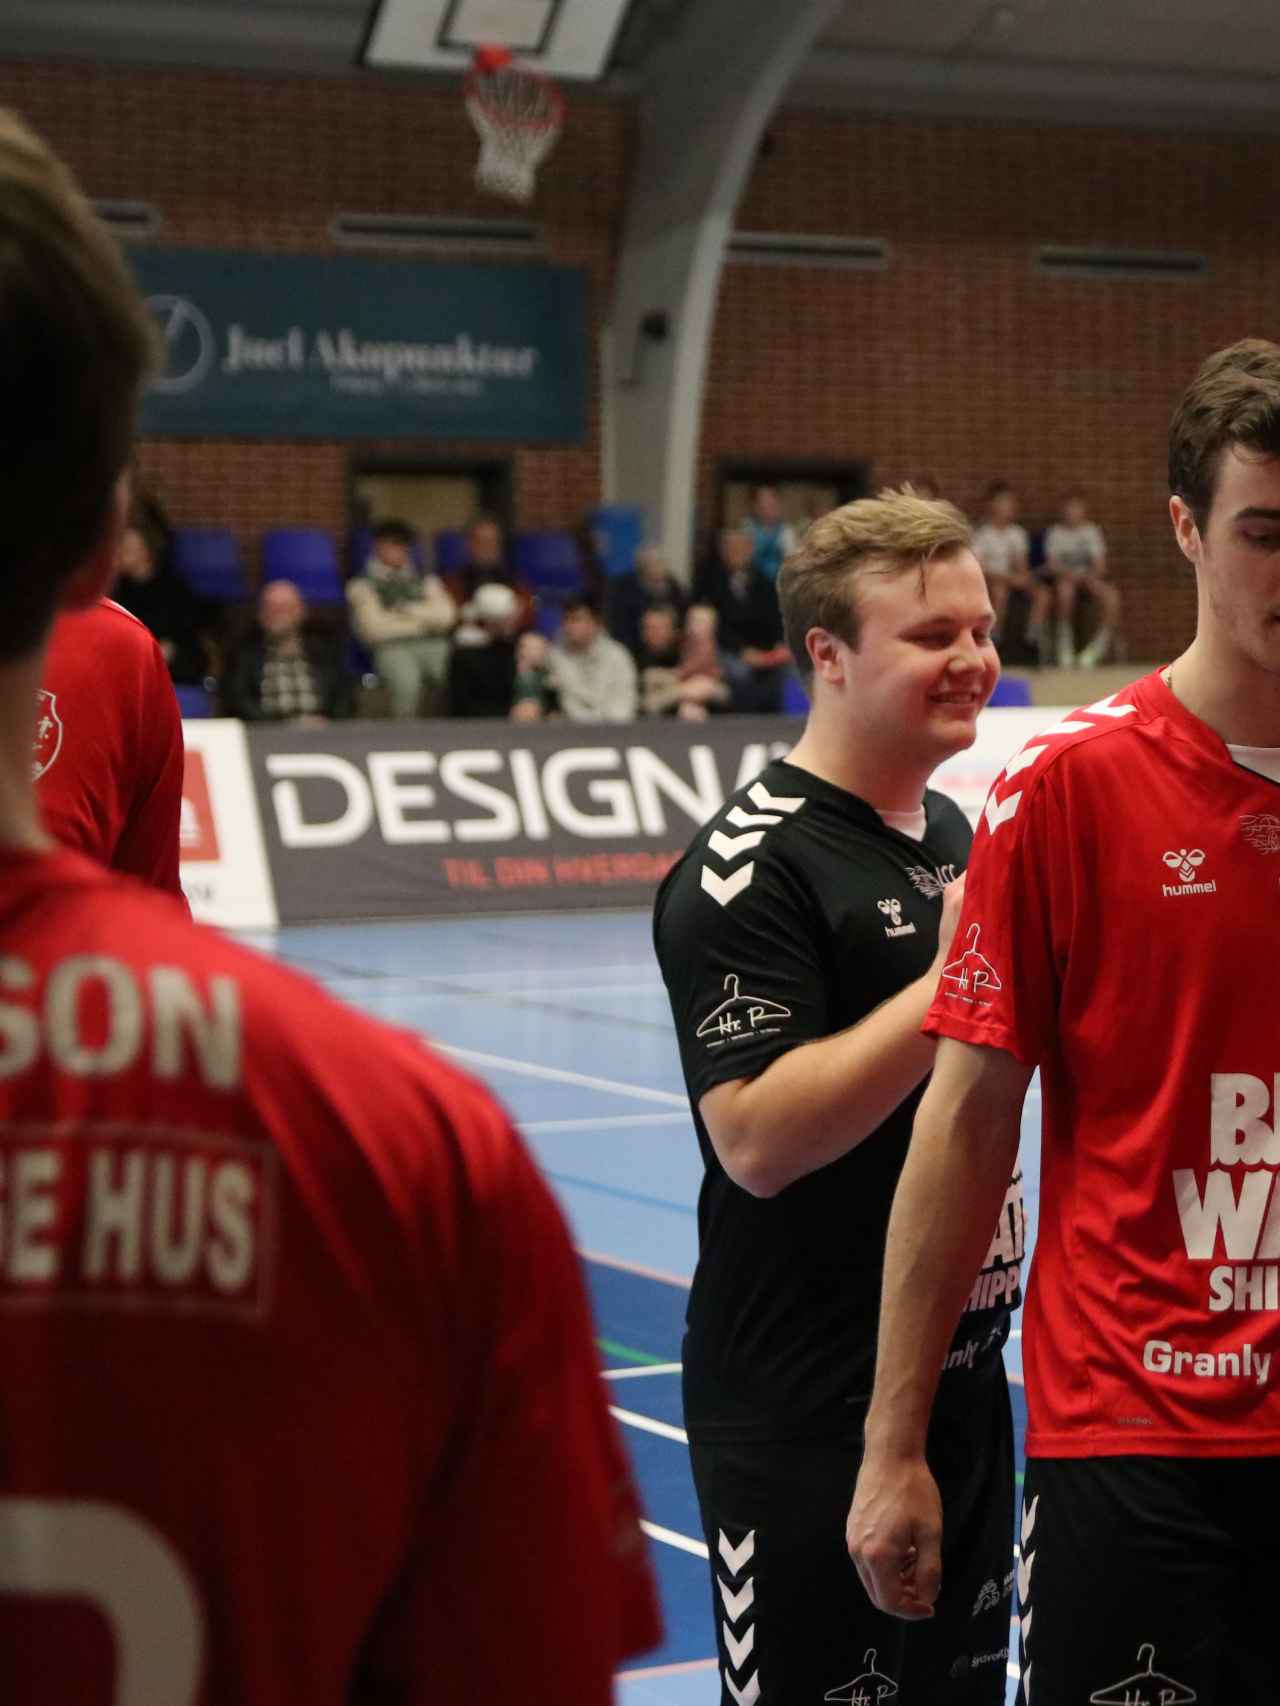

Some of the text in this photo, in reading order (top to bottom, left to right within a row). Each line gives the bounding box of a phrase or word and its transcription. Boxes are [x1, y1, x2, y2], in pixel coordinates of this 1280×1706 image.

[1162, 879, 1217, 898] hummel
[84, 1146, 257, 1293] HUS
[1143, 1340, 1272, 1385] Granly
